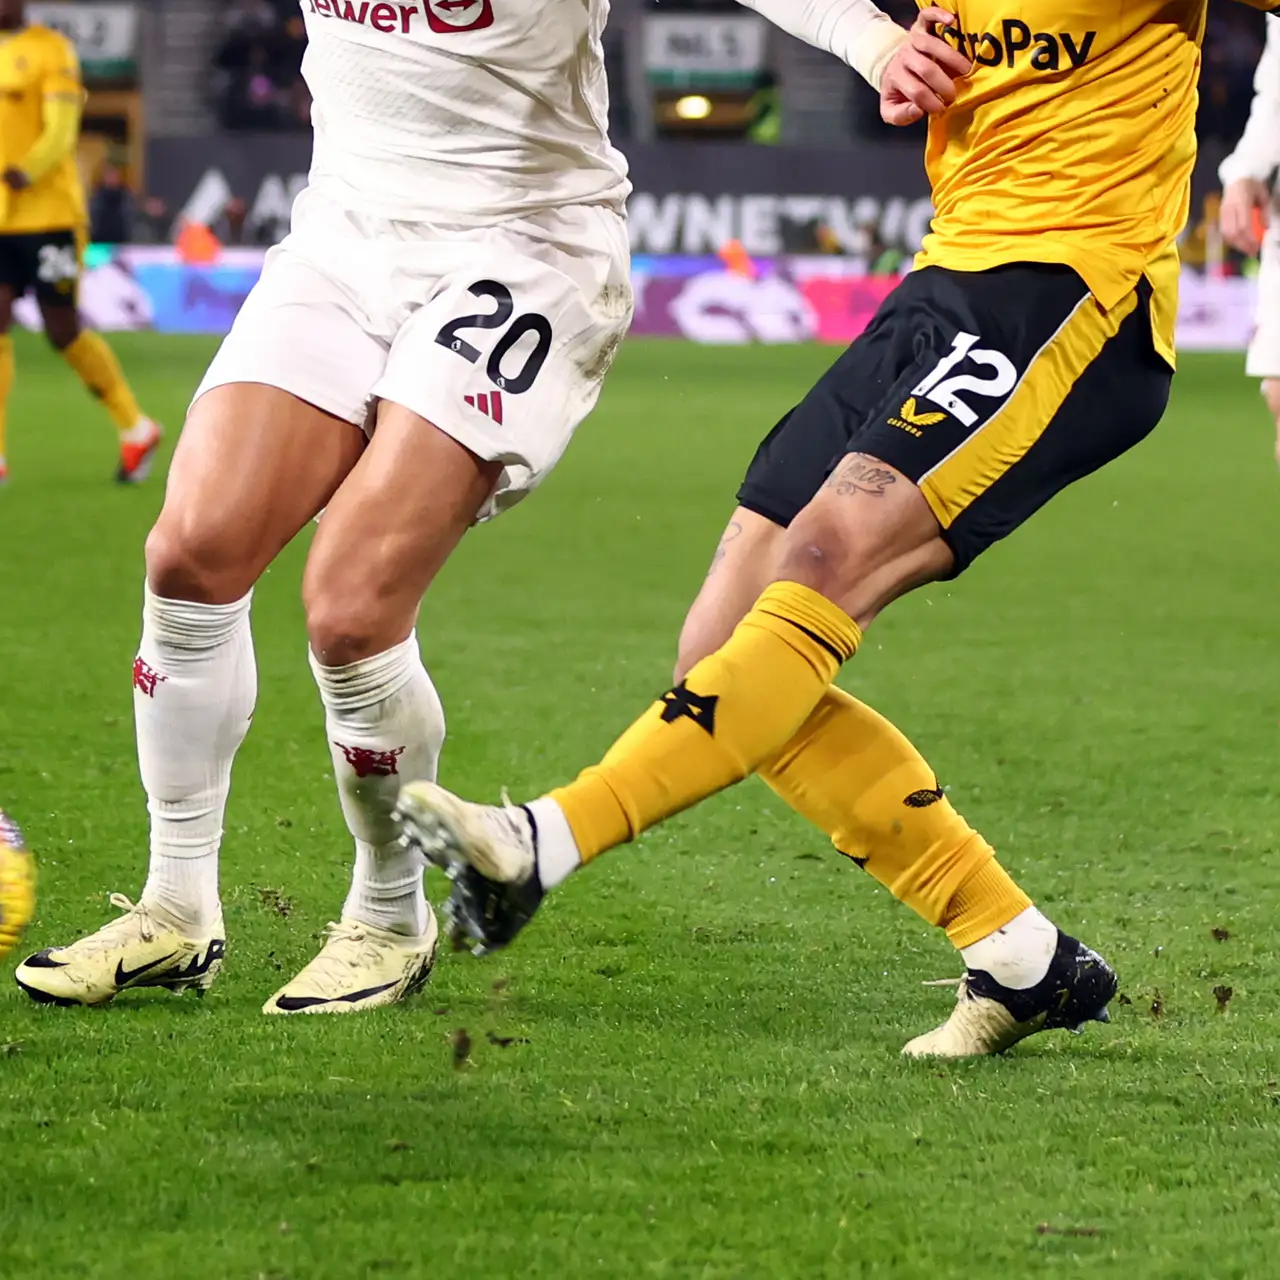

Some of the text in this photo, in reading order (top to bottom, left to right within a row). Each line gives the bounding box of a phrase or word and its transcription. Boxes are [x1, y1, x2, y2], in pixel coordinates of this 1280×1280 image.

[932, 18, 1097, 71] troPay
[434, 279, 552, 394] 20
[910, 331, 1018, 427] 12
